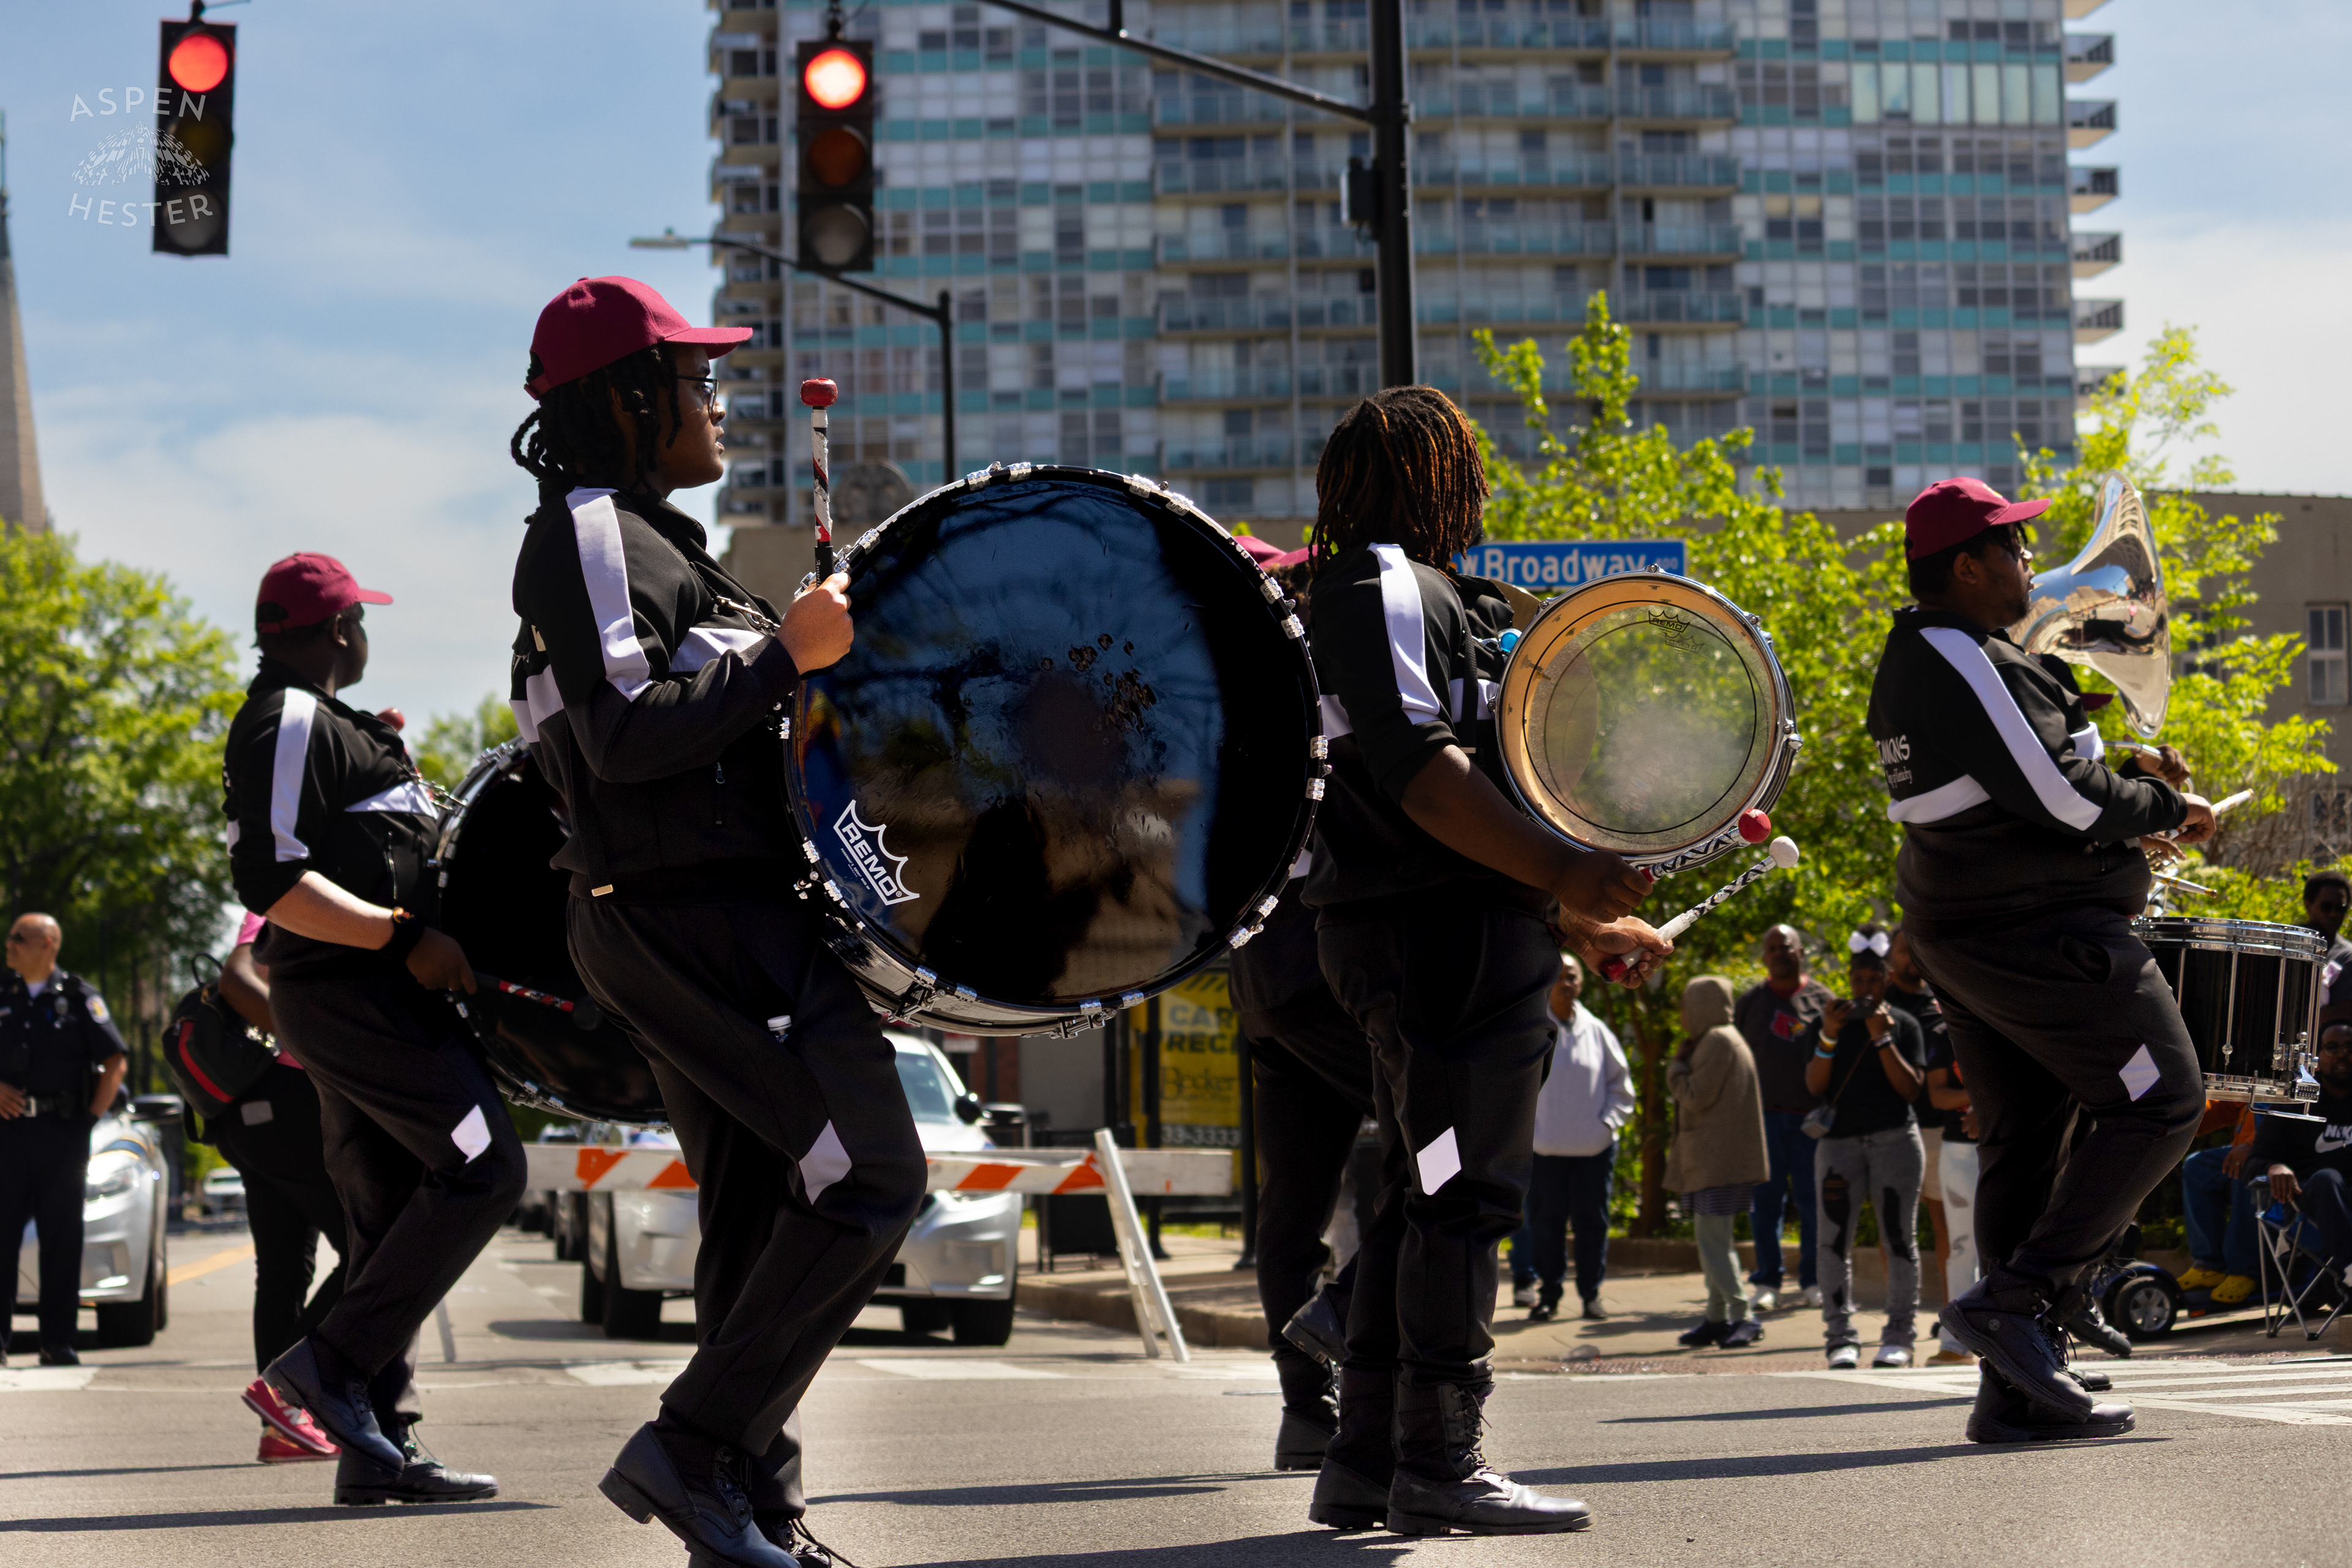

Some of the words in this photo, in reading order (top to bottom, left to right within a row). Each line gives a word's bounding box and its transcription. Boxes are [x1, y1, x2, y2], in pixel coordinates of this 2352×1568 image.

[1484, 548, 1646, 584] Broadway
[1652, 617, 1683, 630] REMO
[842, 822, 898, 897] REMO
[1168, 1005, 1234, 1030] CAR
[1166, 1031, 1238, 1055] REC
[2324, 1125, 2352, 1140] NIK
